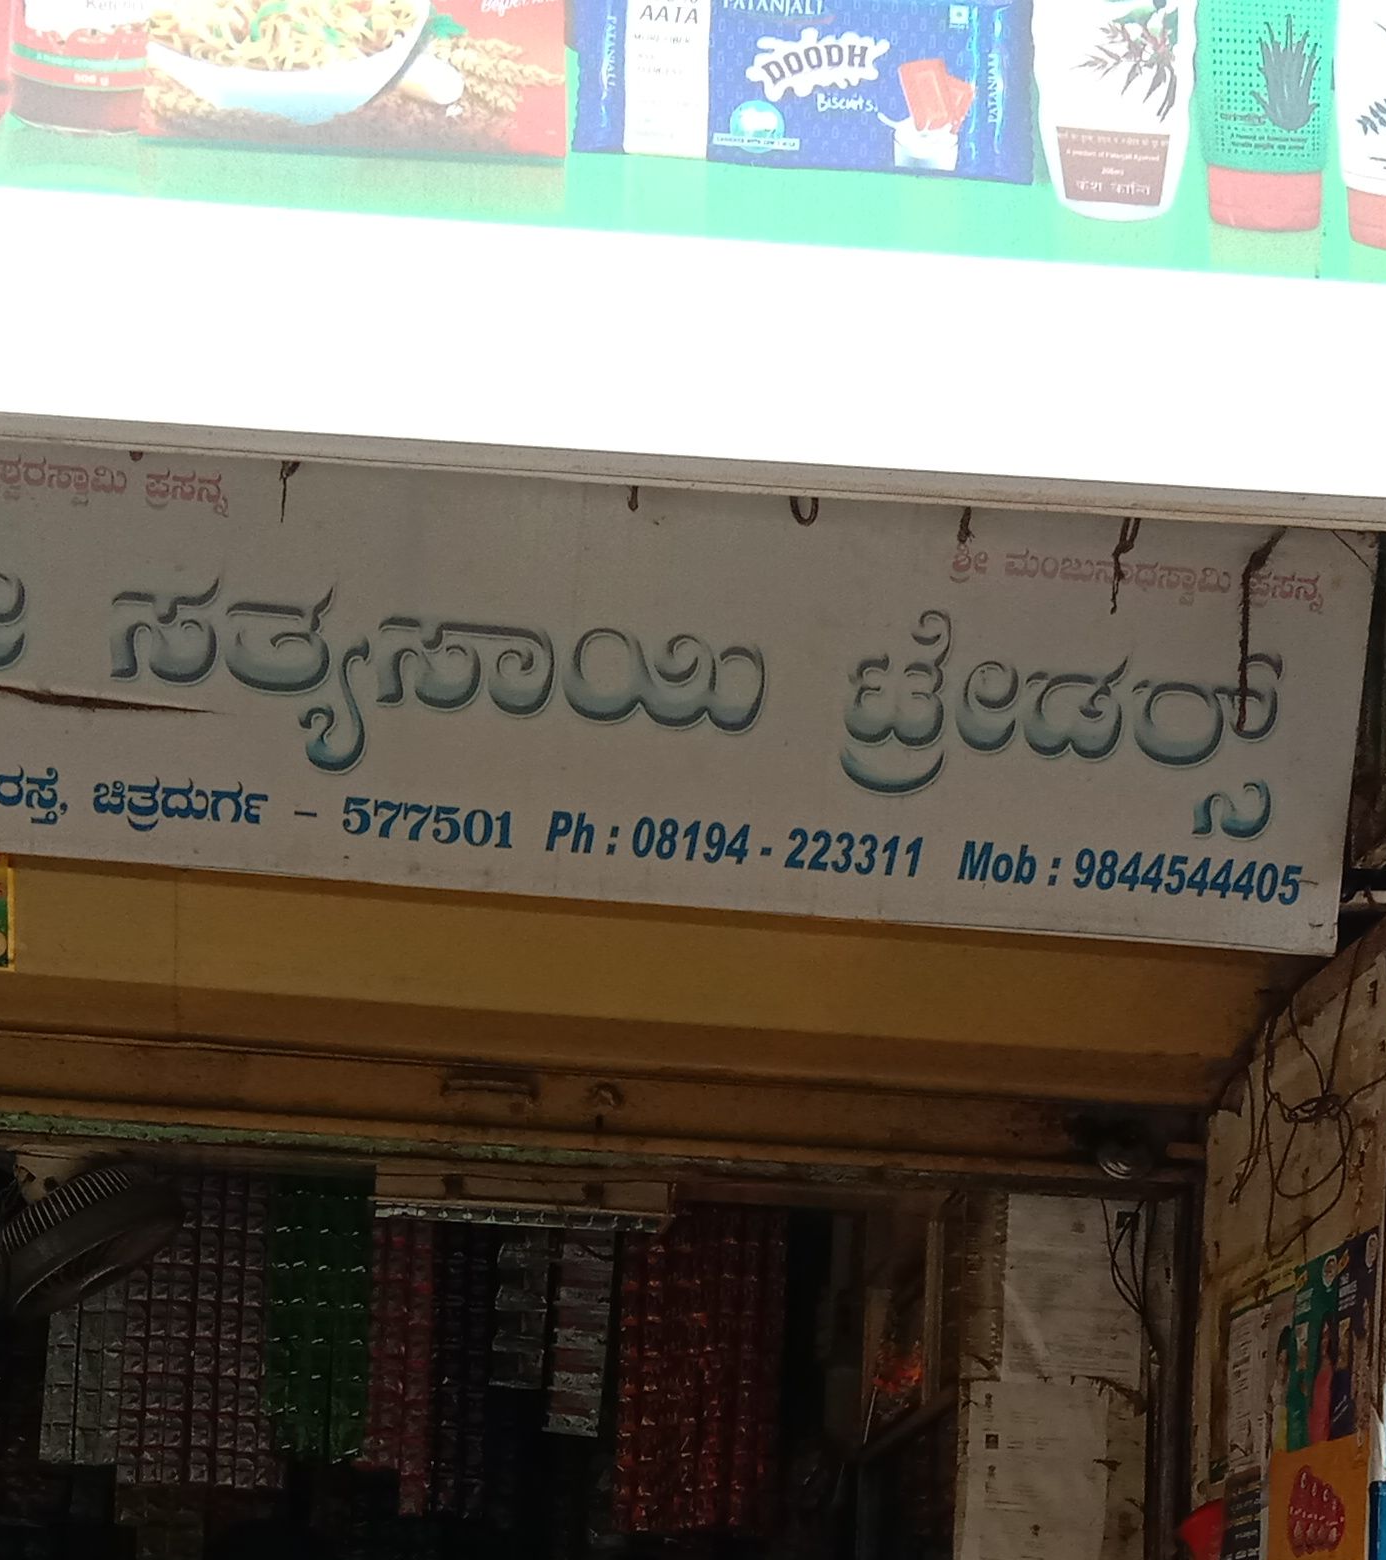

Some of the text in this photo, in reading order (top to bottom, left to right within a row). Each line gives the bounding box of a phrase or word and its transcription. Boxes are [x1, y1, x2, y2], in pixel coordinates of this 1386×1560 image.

[762, 43, 870, 85] DOODH
[143, 471, 231, 518] ಪ್ರಸನ್ನ
[948, 540, 990, 586] ಶ್ರೀ
[108, 572, 767, 775] ಸತ್ಯಸಾಯಿ
[92, 777, 270, 833] ಚಿತ್ರದುರ್ಗ
[340, 793, 514, 852] 577501
[546, 809, 597, 856] Ph
[631, 814, 750, 867] 08194
[786, 826, 926, 878] 223311
[956, 839, 1037, 886] Mob
[1072, 844, 1307, 908] 9844544405
